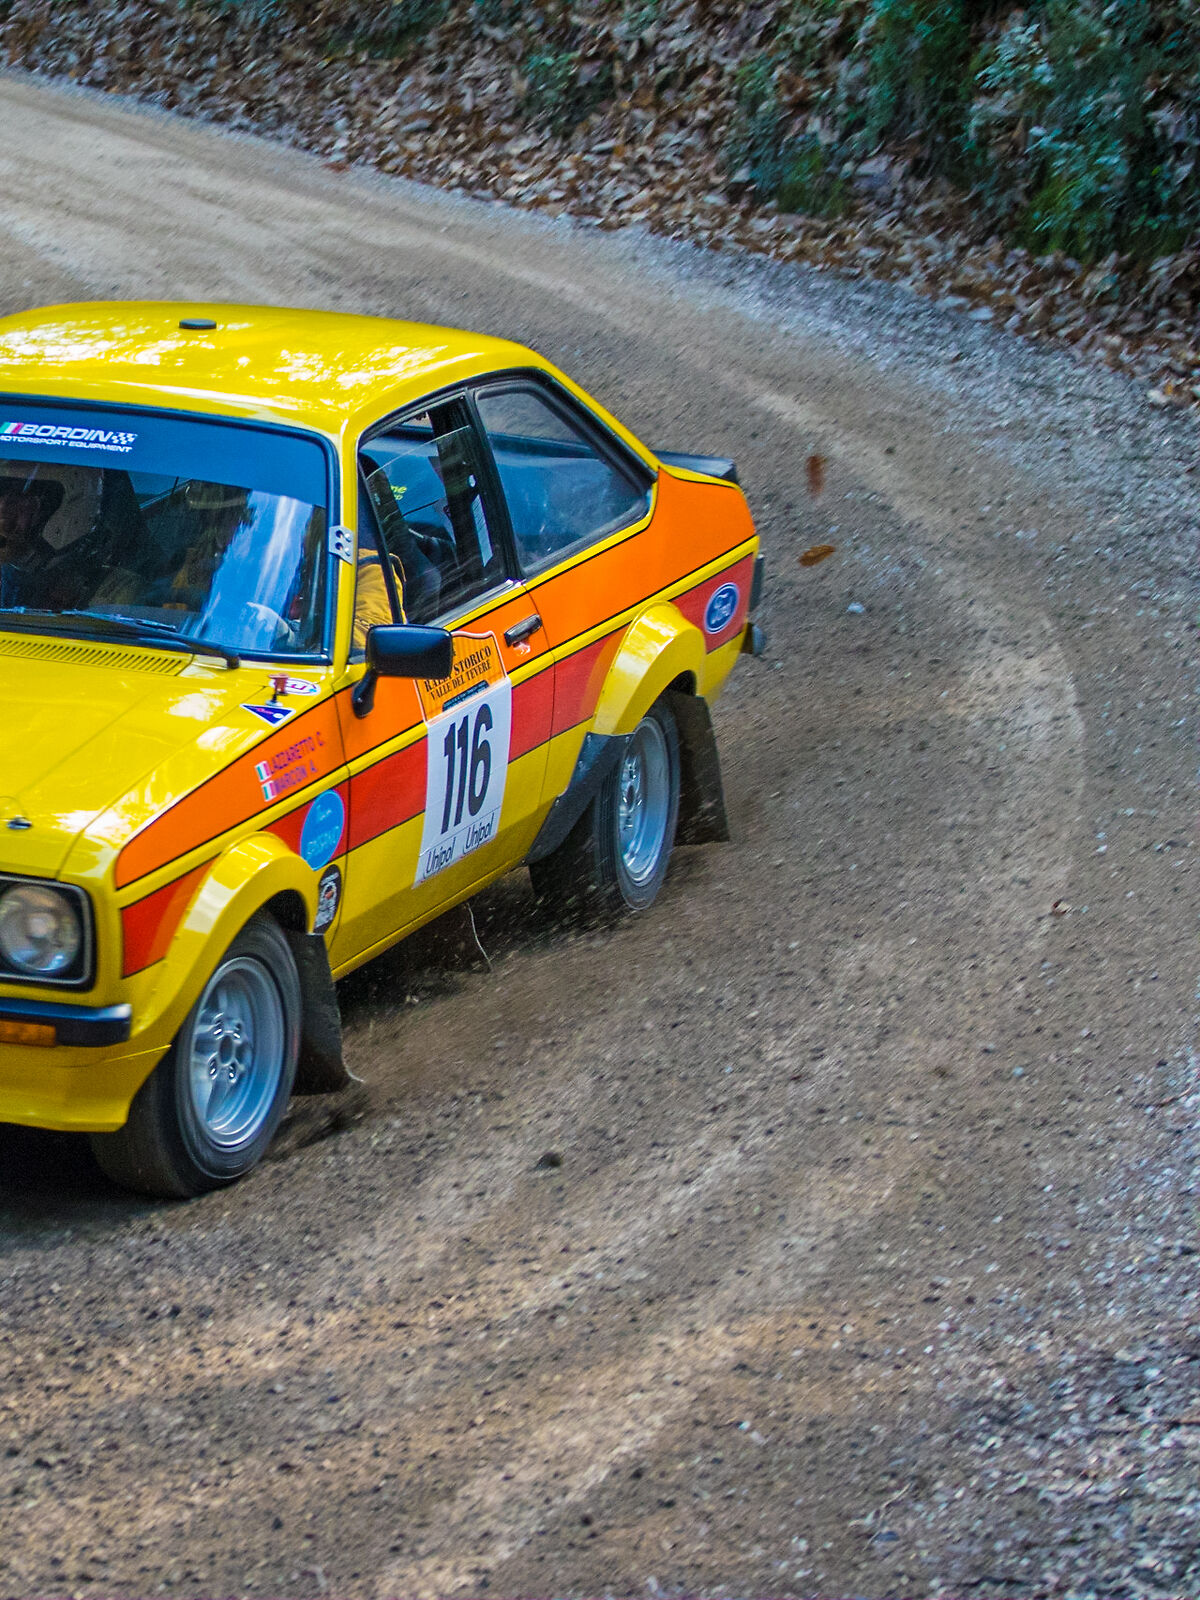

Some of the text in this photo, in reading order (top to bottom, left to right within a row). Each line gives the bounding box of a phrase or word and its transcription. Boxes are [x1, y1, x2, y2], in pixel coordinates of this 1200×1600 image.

[18, 424, 114, 442] BORDIN
[68, 441, 133, 453] EQUIPMENT
[453, 646, 491, 676] STORICO
[430, 681, 452, 701] VALLE
[452, 672, 465, 690] DEL
[466, 659, 491, 681] TEVERE
[441, 703, 493, 834] 116
[425, 812, 495, 874] Unipol Unipol
